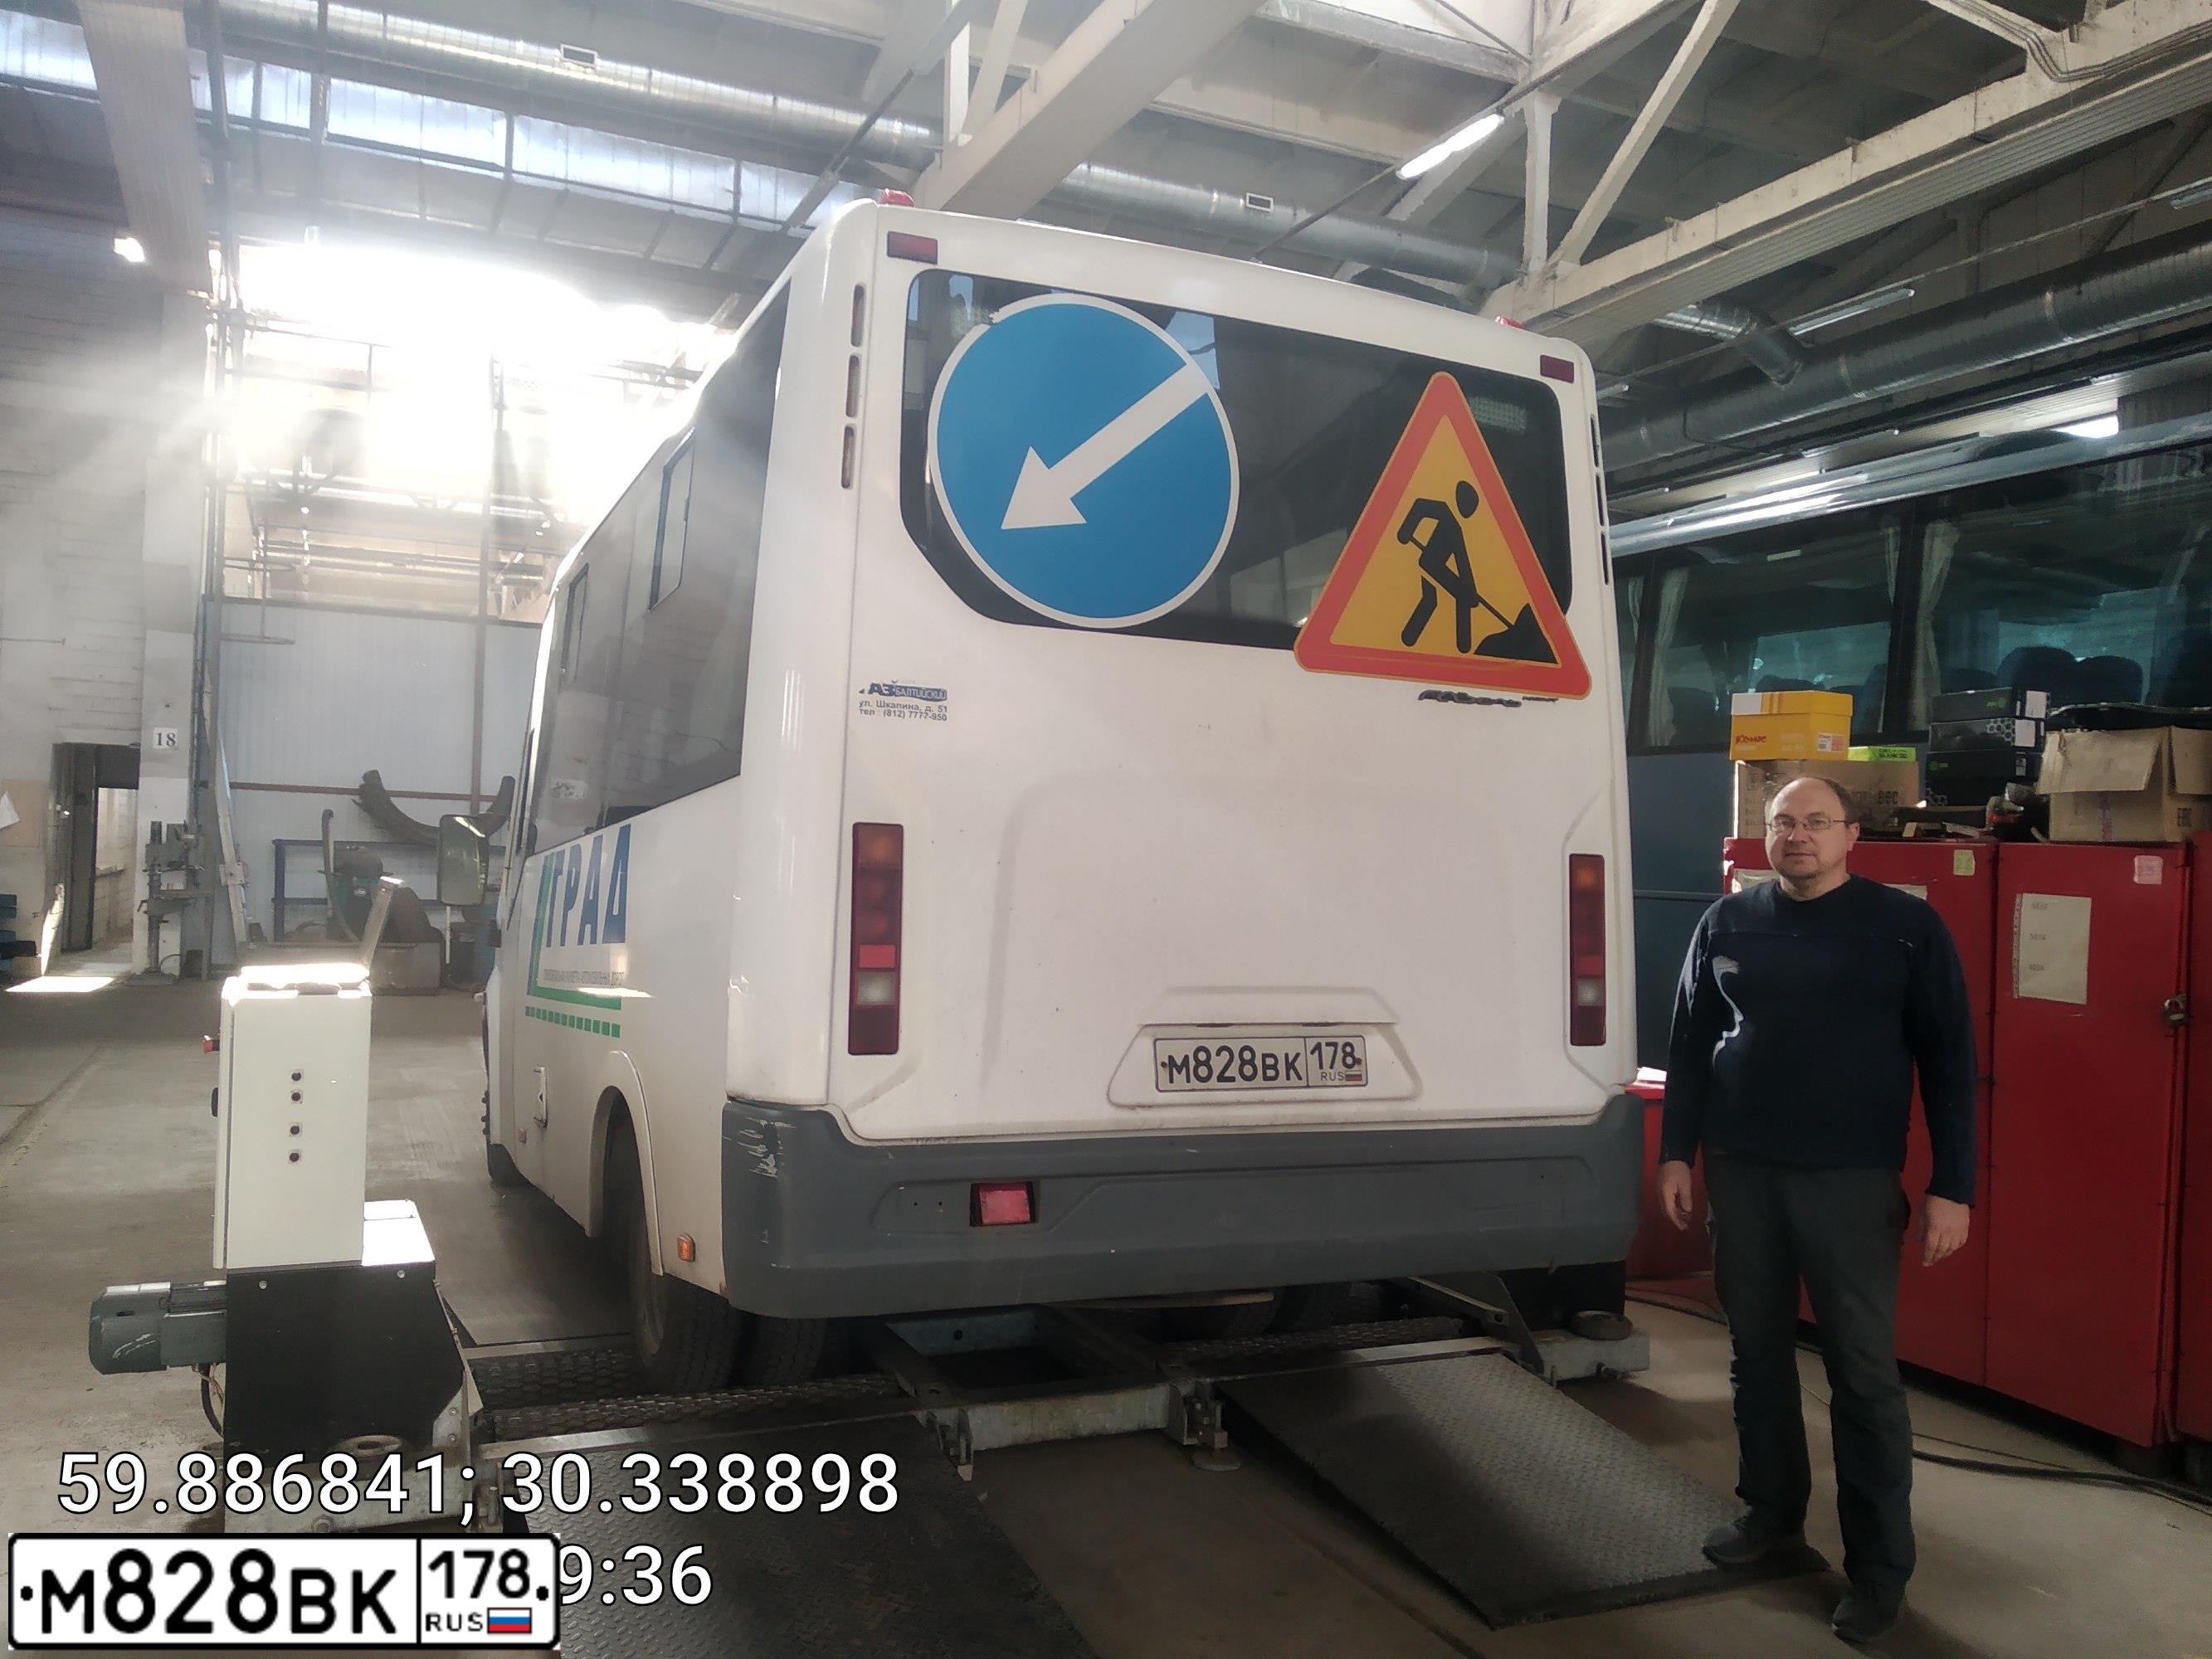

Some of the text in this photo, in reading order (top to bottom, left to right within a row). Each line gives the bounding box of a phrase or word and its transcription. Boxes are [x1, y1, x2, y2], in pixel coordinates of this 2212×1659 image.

[884, 708, 905, 718] (812)
[158, 732, 176, 747] 18
[1167, 1041, 1356, 1084] М828ВК 178
[1320, 1071, 1345, 1082] RUS
